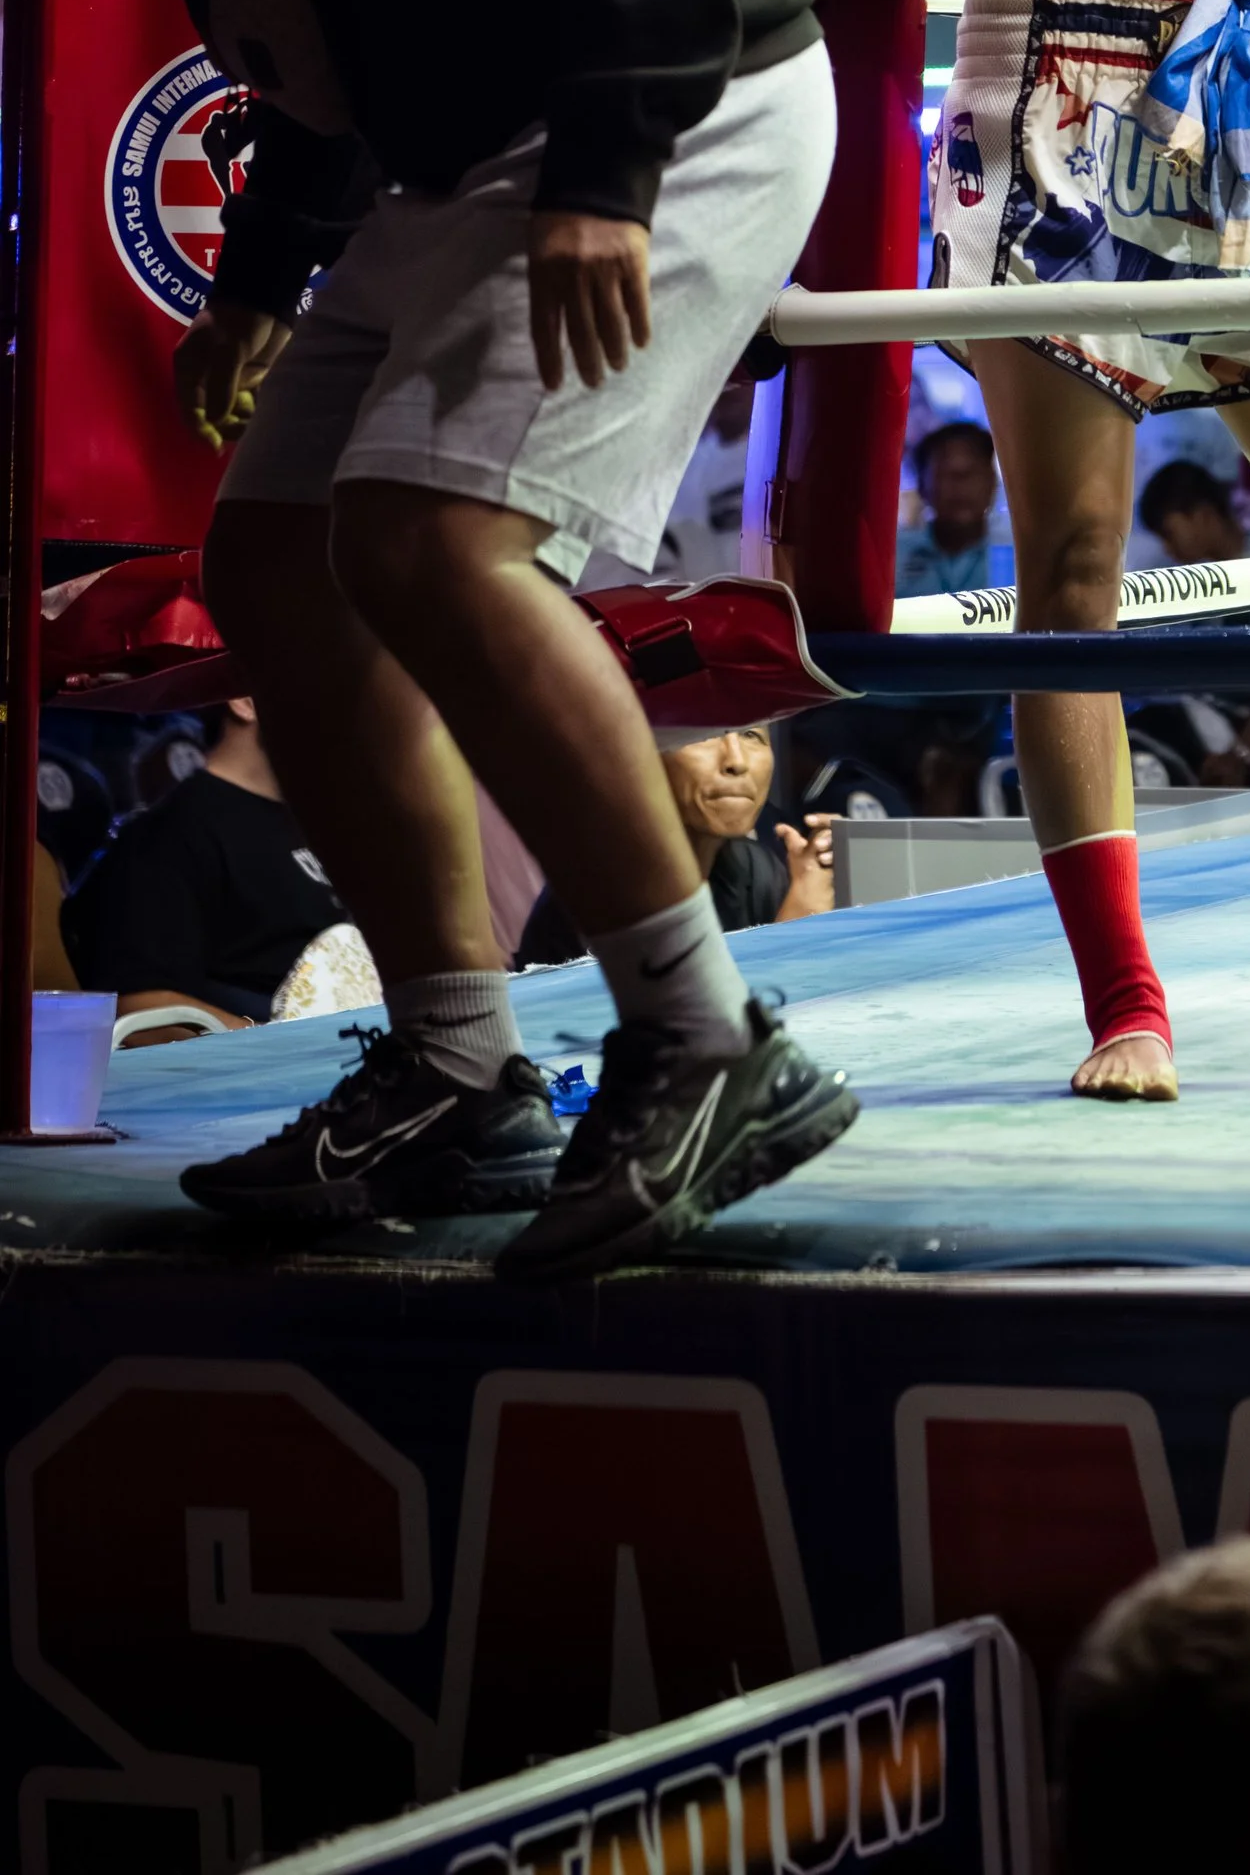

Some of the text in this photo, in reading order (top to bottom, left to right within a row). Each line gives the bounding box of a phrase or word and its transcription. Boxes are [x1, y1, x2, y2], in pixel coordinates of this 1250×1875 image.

[122, 59, 223, 178] SAMUI INTERNA
[447, 1677, 947, 1875] TADIUM
